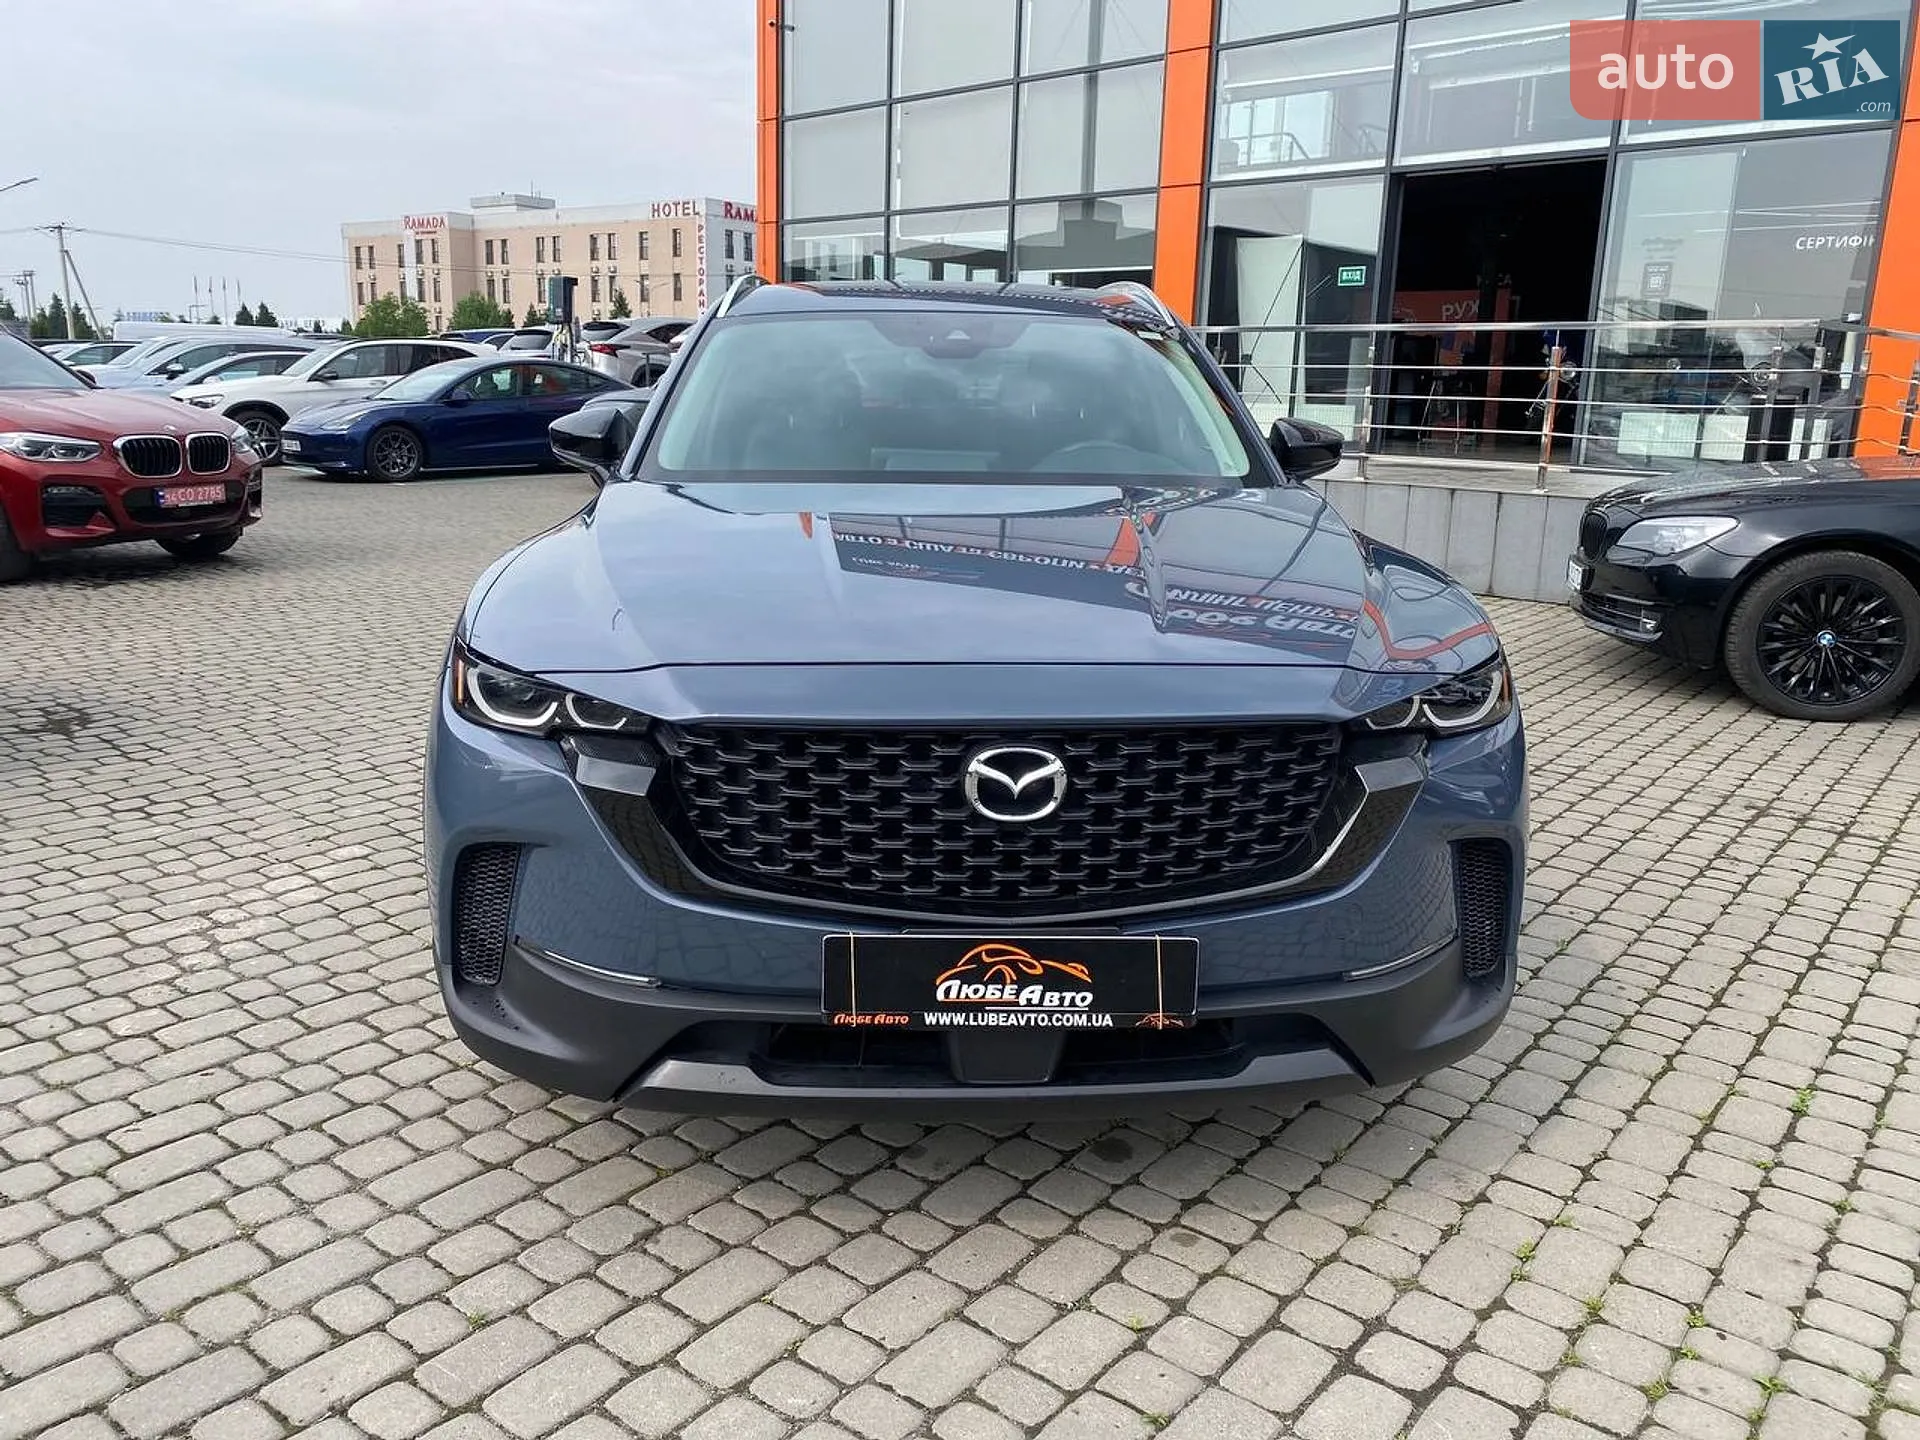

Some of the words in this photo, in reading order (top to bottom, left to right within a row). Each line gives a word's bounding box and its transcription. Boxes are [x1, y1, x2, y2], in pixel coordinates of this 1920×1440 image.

[651, 200, 700, 218] HOTEL
[723, 201, 758, 223] RAM
[403, 215, 445, 229] RAMADA
[1342, 270, 1361, 282] ВХІД
[924, 1011, 1114, 1027] WWW.LUBEAVTO.COM.UA
